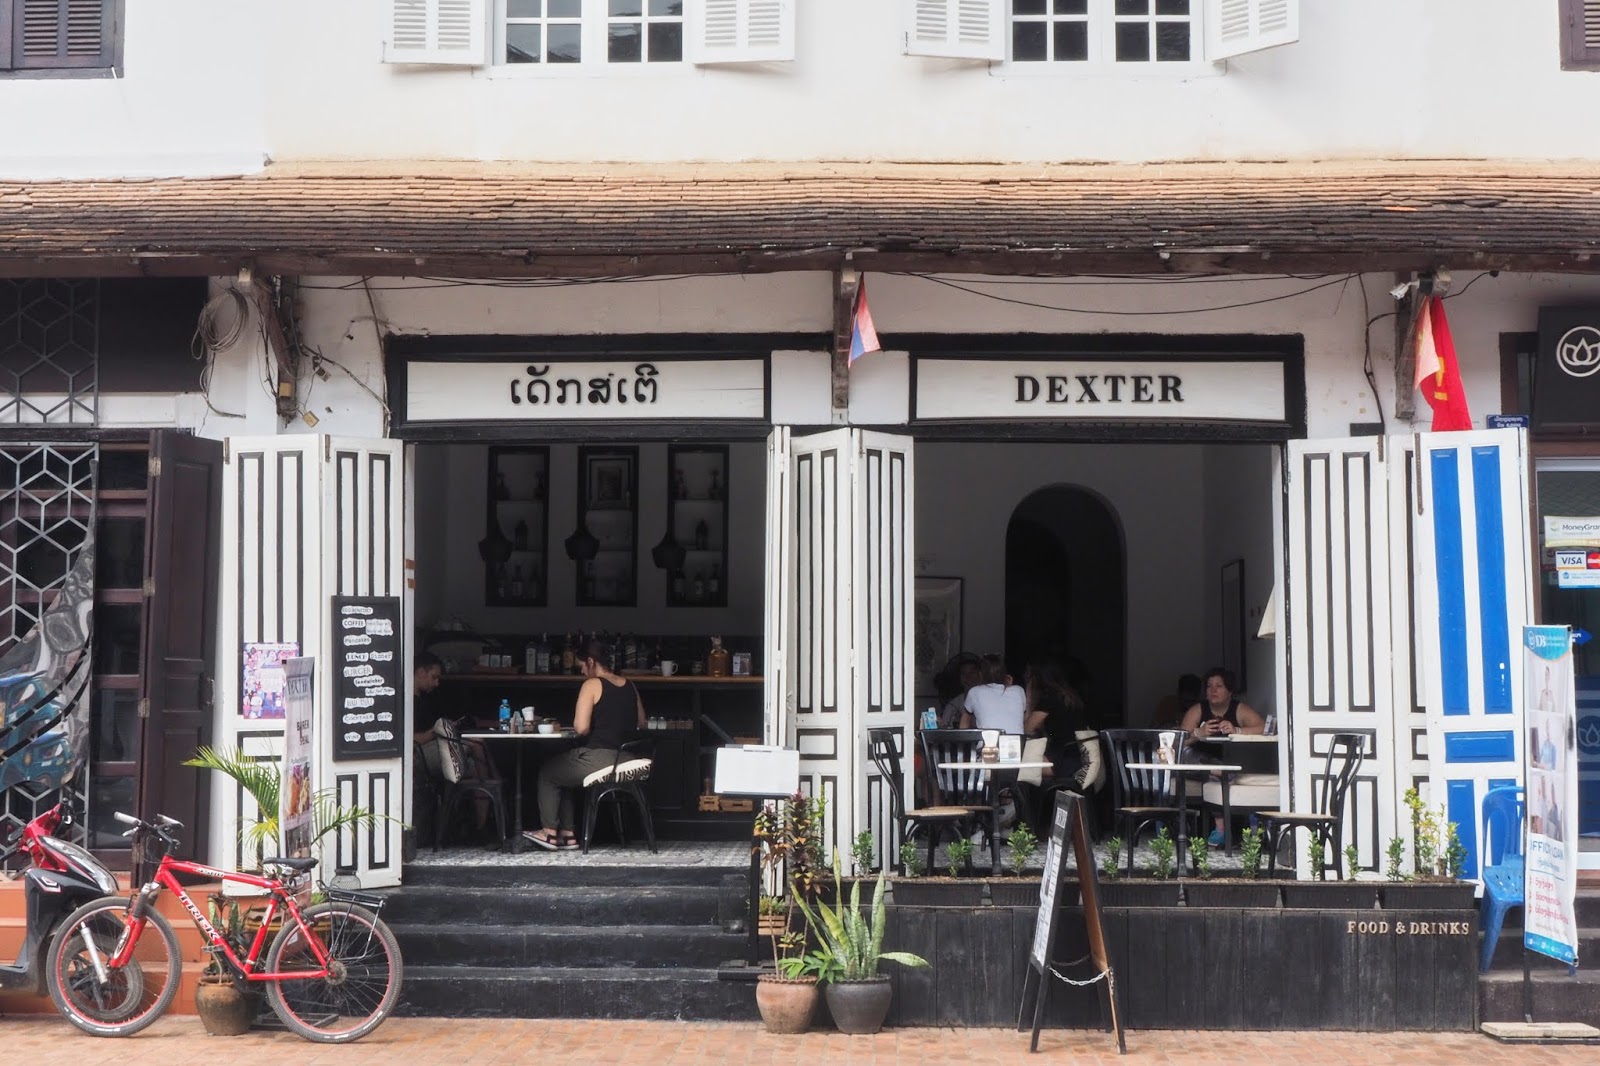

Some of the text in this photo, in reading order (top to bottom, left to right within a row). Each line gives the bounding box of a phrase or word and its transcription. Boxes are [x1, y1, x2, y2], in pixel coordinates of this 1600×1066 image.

[1014, 375, 1185, 403] DEXTER
[1561, 556, 1583, 565] VISA
[180, 891, 220, 941] TREK
[1347, 921, 1470, 935] FOOD & DRINKS
